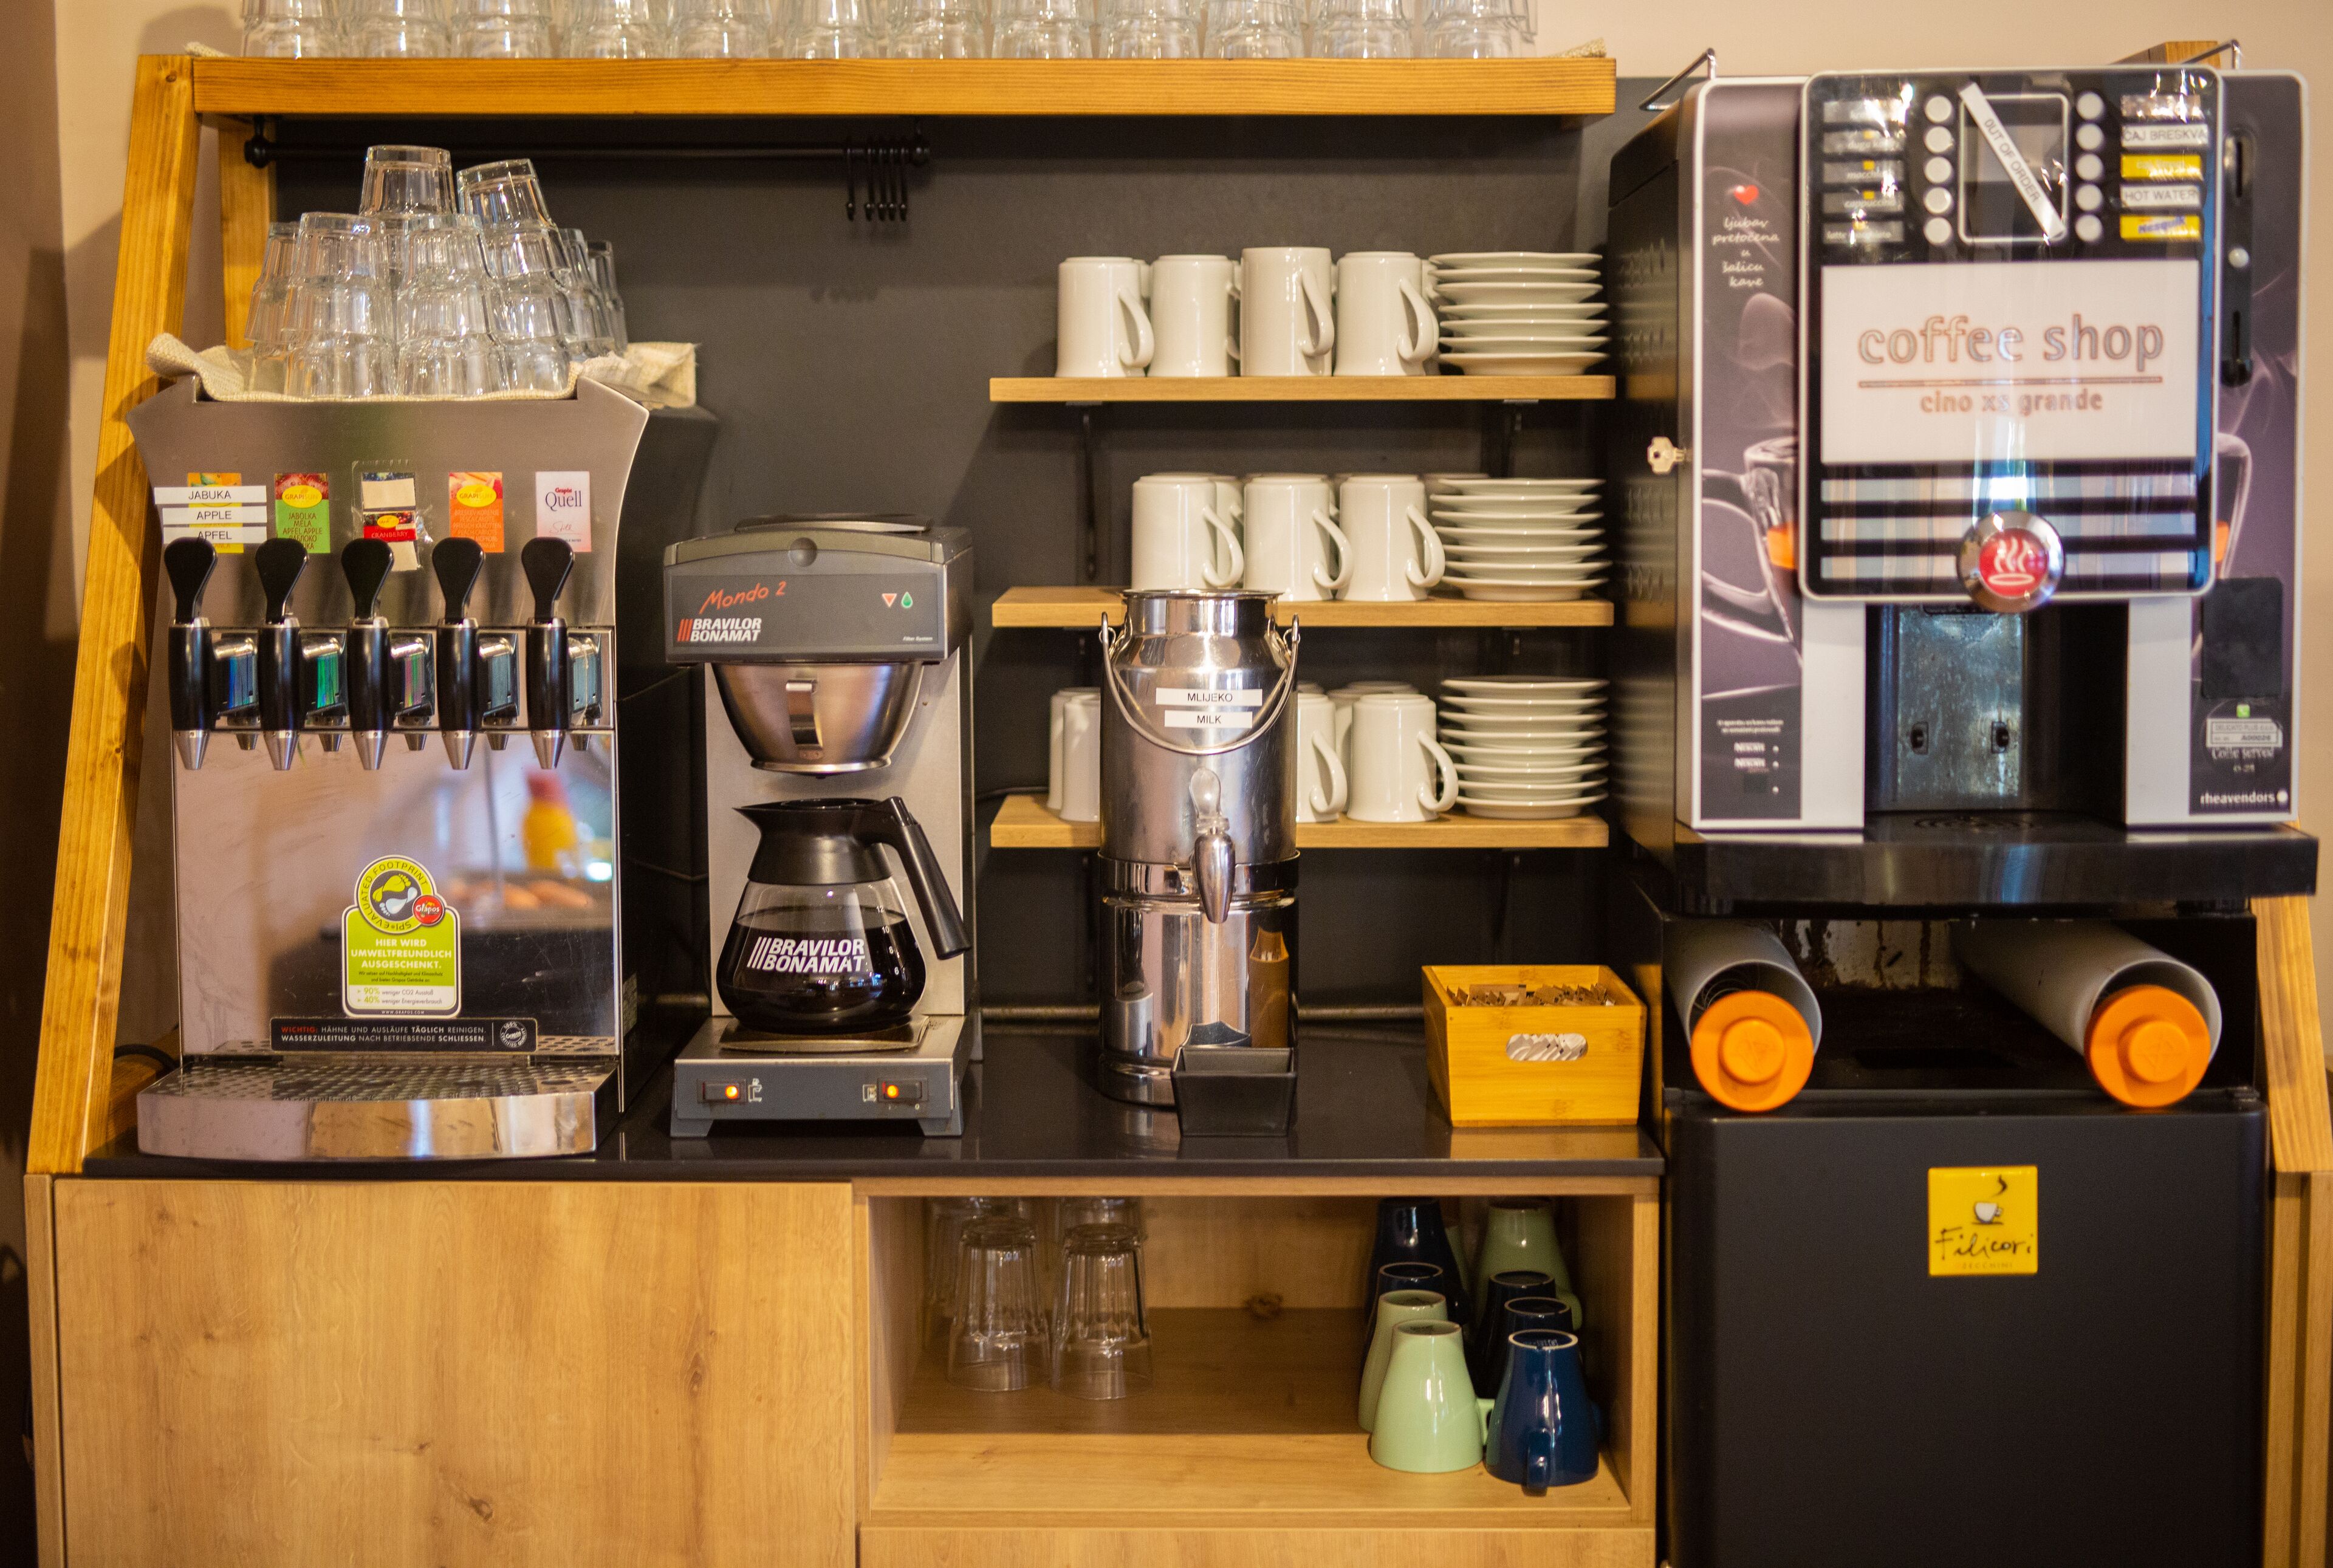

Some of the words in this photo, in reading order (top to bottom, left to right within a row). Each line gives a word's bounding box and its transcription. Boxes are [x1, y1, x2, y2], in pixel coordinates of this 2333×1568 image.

[2150, 127, 2207, 140] BRESKVA
[1984, 118, 2003, 142] OUT
[1999, 140, 2013, 160] OF
[2010, 158, 2040, 204] ORDER
[2125, 190, 2150, 201] HOT
[2153, 189, 2197, 200] WATER
[1730, 276, 1764, 288] kave
[1859, 315, 2024, 364] coffee
[2043, 313, 2163, 371] shop
[1920, 391, 1973, 413] cino
[1981, 394, 2010, 411] xs
[2018, 388, 2103, 416] grande
[188, 490, 231, 500] JABUKA
[545, 491, 582, 512] Quell
[197, 511, 231, 520] APPLE
[197, 530, 232, 540] APFEL
[699, 583, 769, 615] Mondo
[775, 581, 787, 597] 2
[692, 618, 762, 630] BRAVILOR
[690, 629, 761, 642] BONAMAT
[1187, 693, 1233, 703] MLIJEKO
[1197, 715, 1222, 725] MILK
[2200, 790, 2275, 804] rheavendors
[372, 861, 428, 885] FOOTPRINT
[361, 875, 389, 929] EVALUATED
[375, 939, 397, 947] HIER
[400, 939, 427, 947] WIRD
[769, 938, 865, 956] BRAVILOR
[351, 949, 452, 959] UMWELTFREUNDLICH
[361, 960, 442, 969] AUSGESCHENKT.
[762, 956, 866, 973] BONAMAT
[411, 1025, 444, 1033] TÄGLICH
